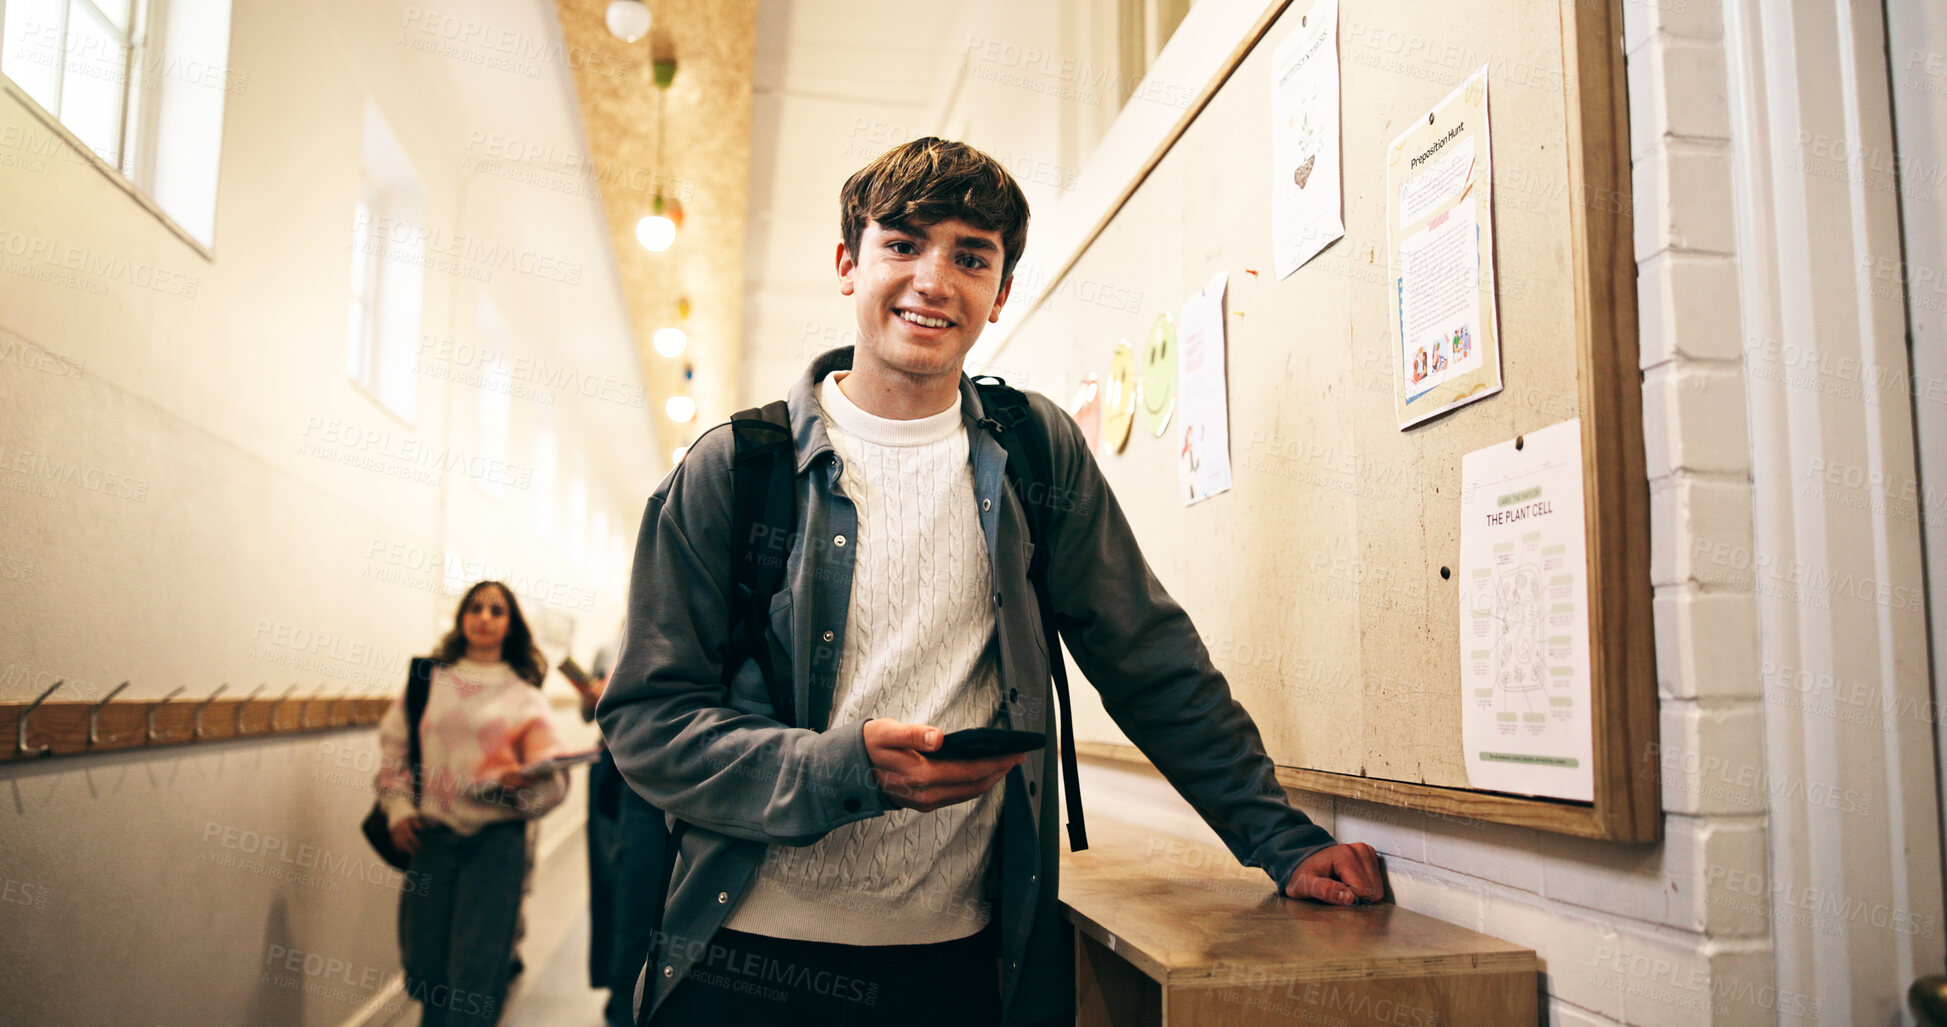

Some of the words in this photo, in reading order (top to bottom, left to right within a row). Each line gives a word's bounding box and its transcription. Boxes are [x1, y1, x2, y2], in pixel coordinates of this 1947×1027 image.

[1410, 137, 1448, 170] Preposition
[1448, 121, 1465, 141] Hunt
[1486, 512, 1503, 527] THE
[1505, 505, 1530, 523] PLANT
[1532, 500, 1553, 517] CELL
